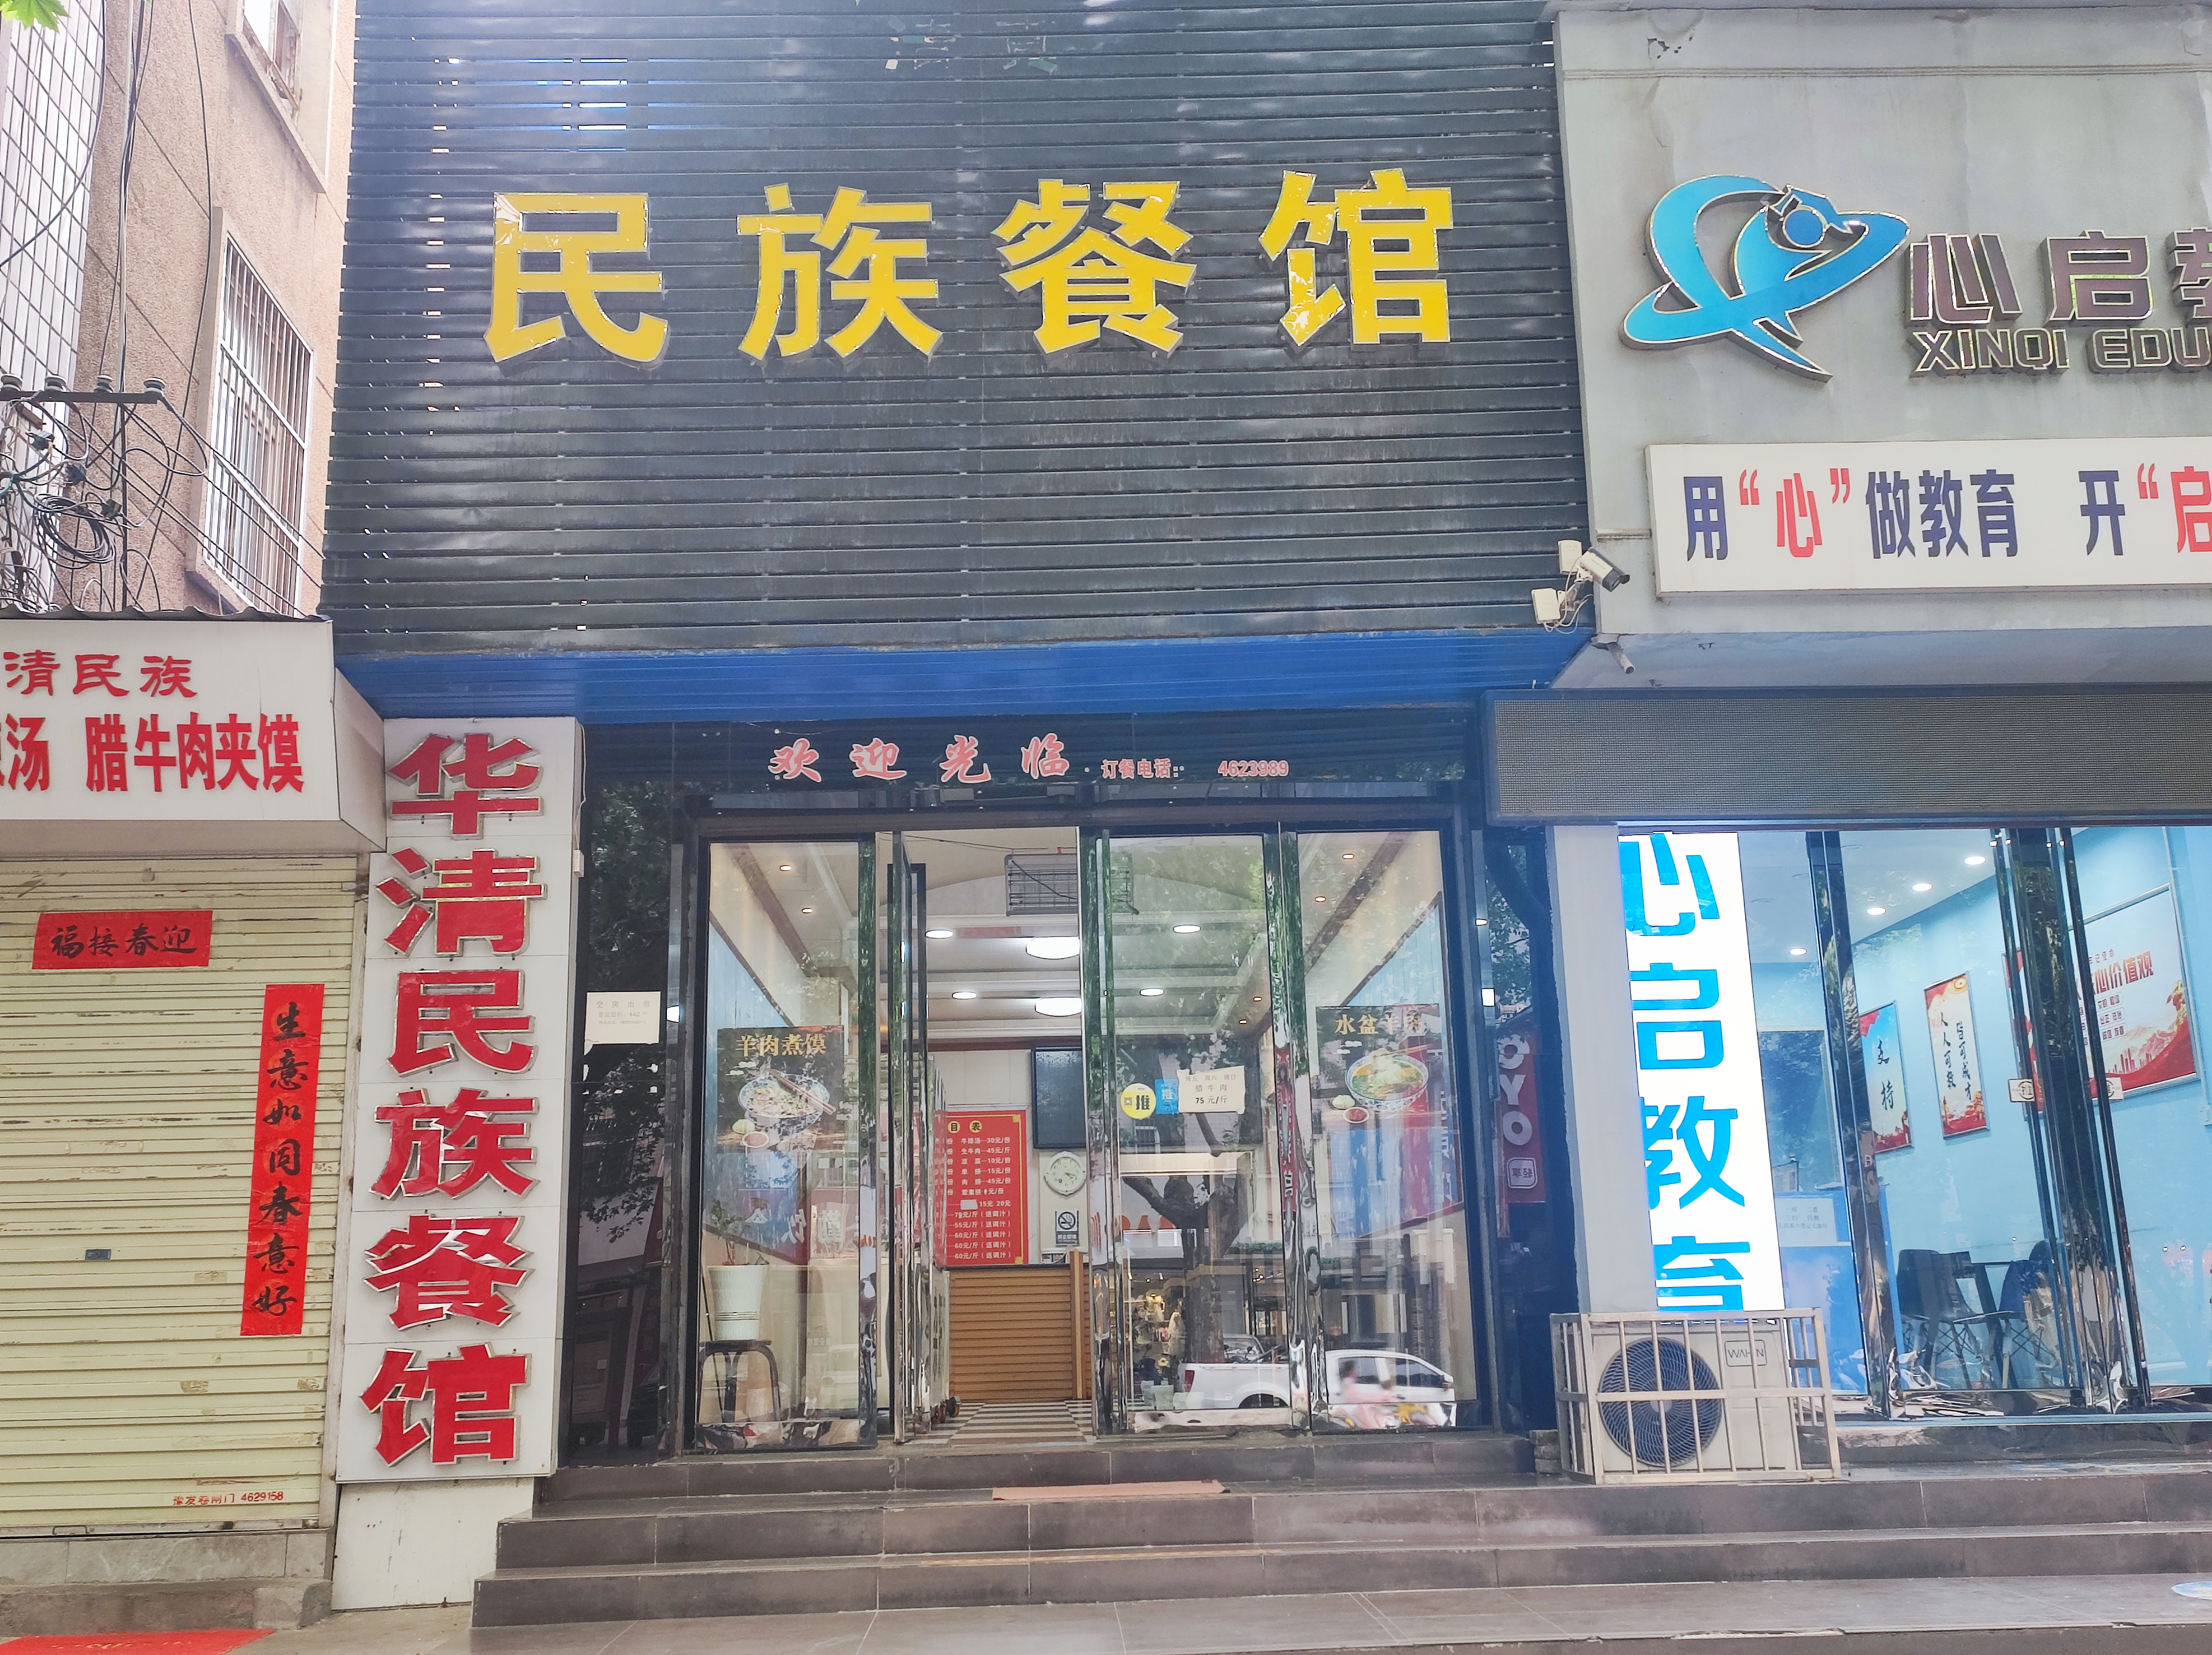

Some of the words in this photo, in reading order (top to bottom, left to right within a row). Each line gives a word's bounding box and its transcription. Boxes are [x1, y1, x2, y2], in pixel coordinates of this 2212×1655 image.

[482, 168, 1454, 368] 民族餐馆
[1909, 327, 2071, 375] XINQI
[2, 649, 198, 698] 清民族
[0, 714, 51, 792] 汤
[85, 712, 304, 793] 腊牛肉夹馍
[768, 733, 1070, 783] 欢迎光临
[1217, 760, 1289, 777] 4623989
[2091, 951, 2154, 995] 心价值观
[736, 1033, 827, 1057] 羊肉煮馍
[358, 731, 542, 1466] 华清民族餐馆
[1136, 1095, 1150, 1110] 推
[251, 1001, 308, 1318] 生意如同春意好
[1727, 1348, 1765, 1358] WAHN
[241, 1491, 284, 1502] 4629158
